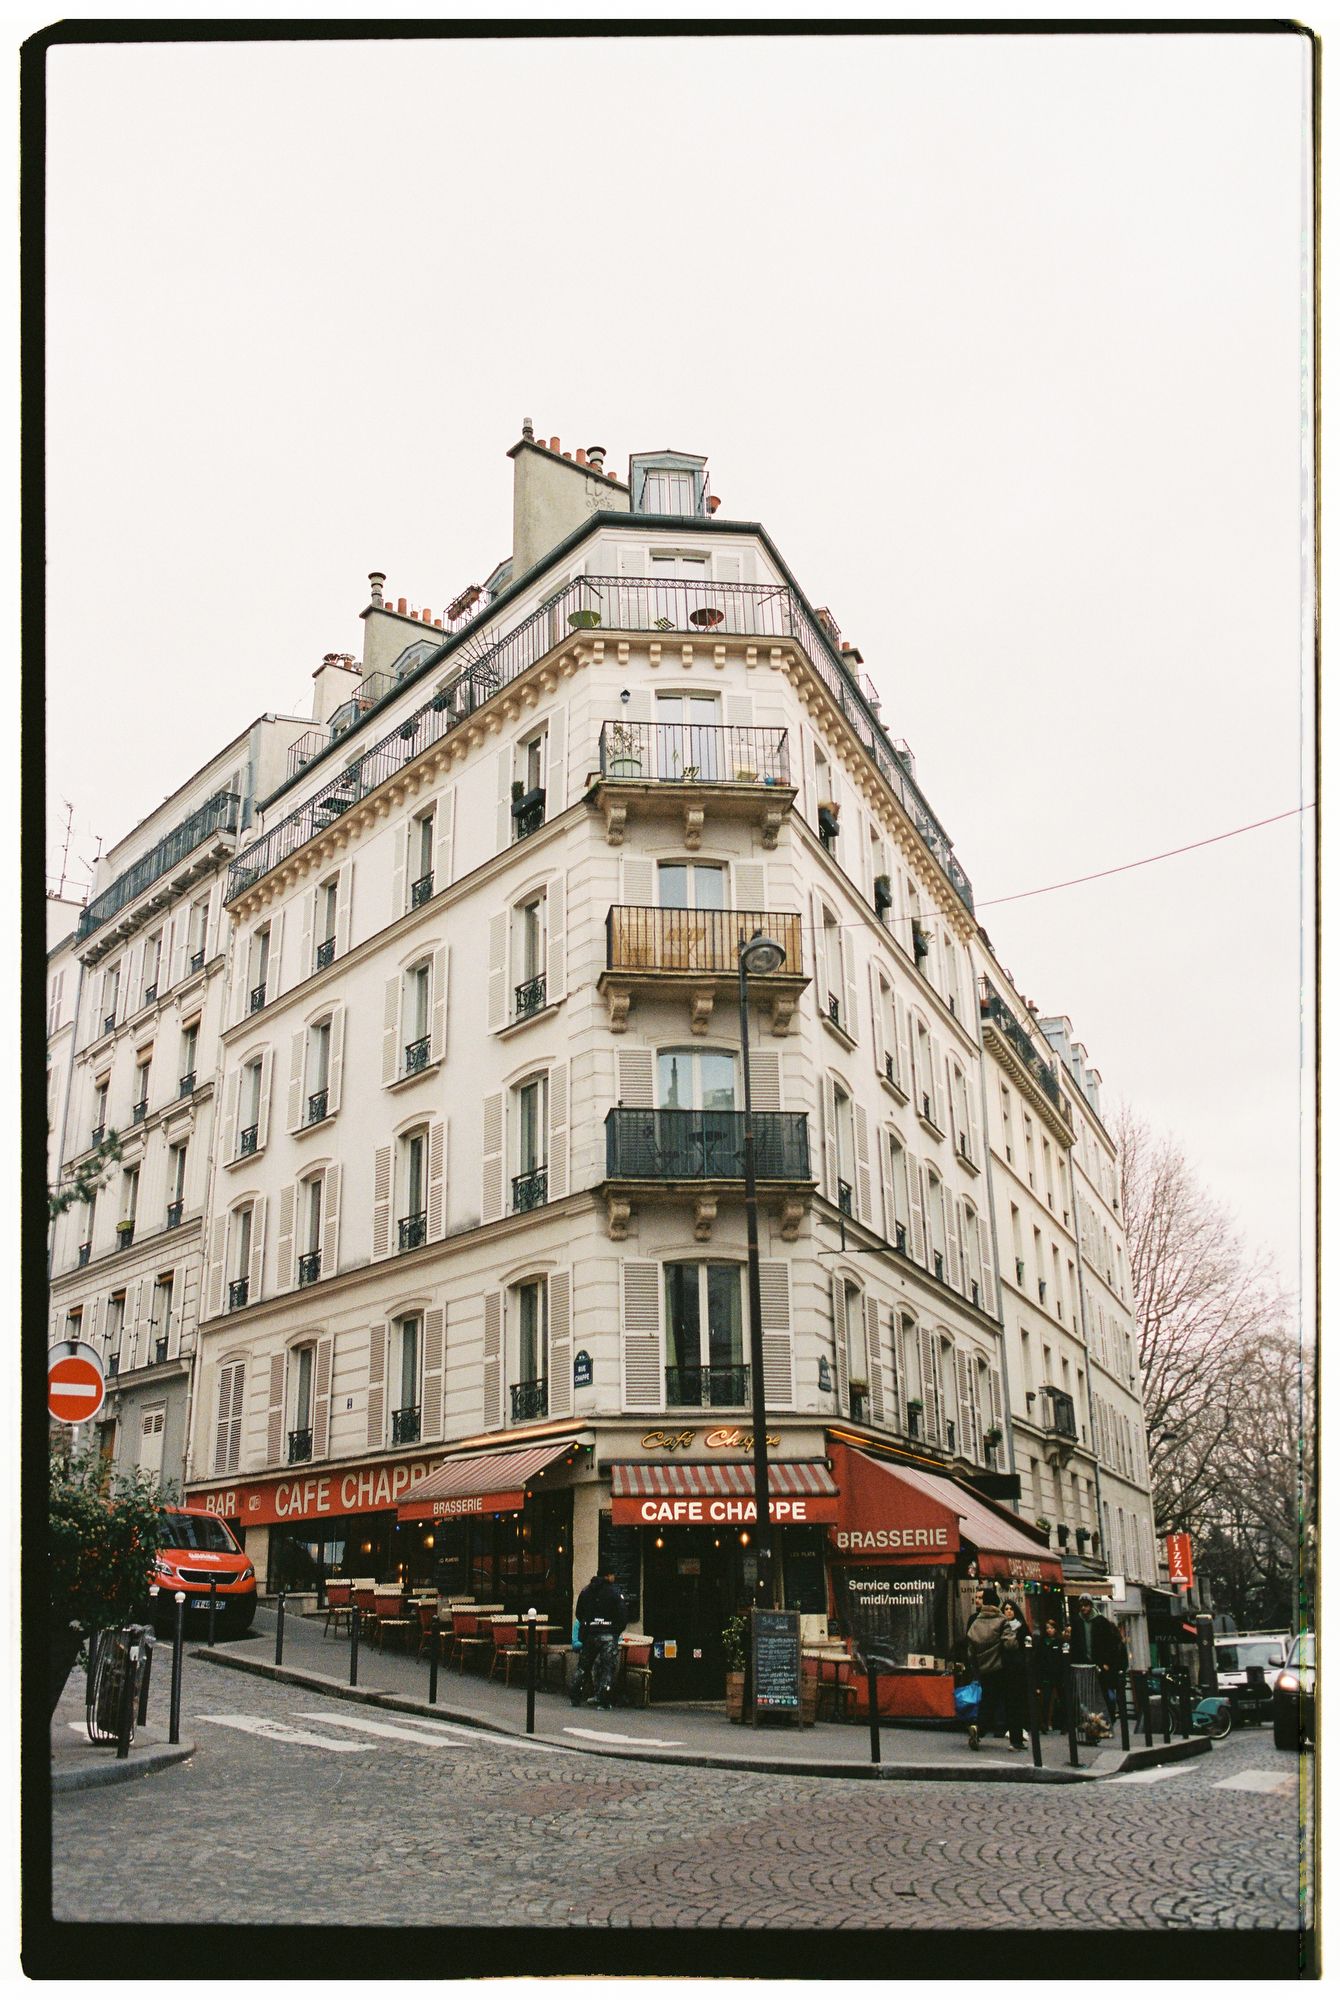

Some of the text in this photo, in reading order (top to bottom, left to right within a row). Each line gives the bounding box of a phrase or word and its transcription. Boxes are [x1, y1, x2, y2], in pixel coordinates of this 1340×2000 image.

[641, 1431, 696, 1451] Café
[206, 1491, 236, 1517] BAR
[275, 1477, 331, 1517] CAFE
[433, 1498, 483, 1515] BRASSERIE
[641, 1501, 703, 1521] CAFE
[837, 1528, 948, 1549] BRASSERIE
[1172, 1535, 1184, 1577] PIZZA
[848, 1580, 935, 1591] Service continu
[860, 1594, 924, 1605] midi/minuit
